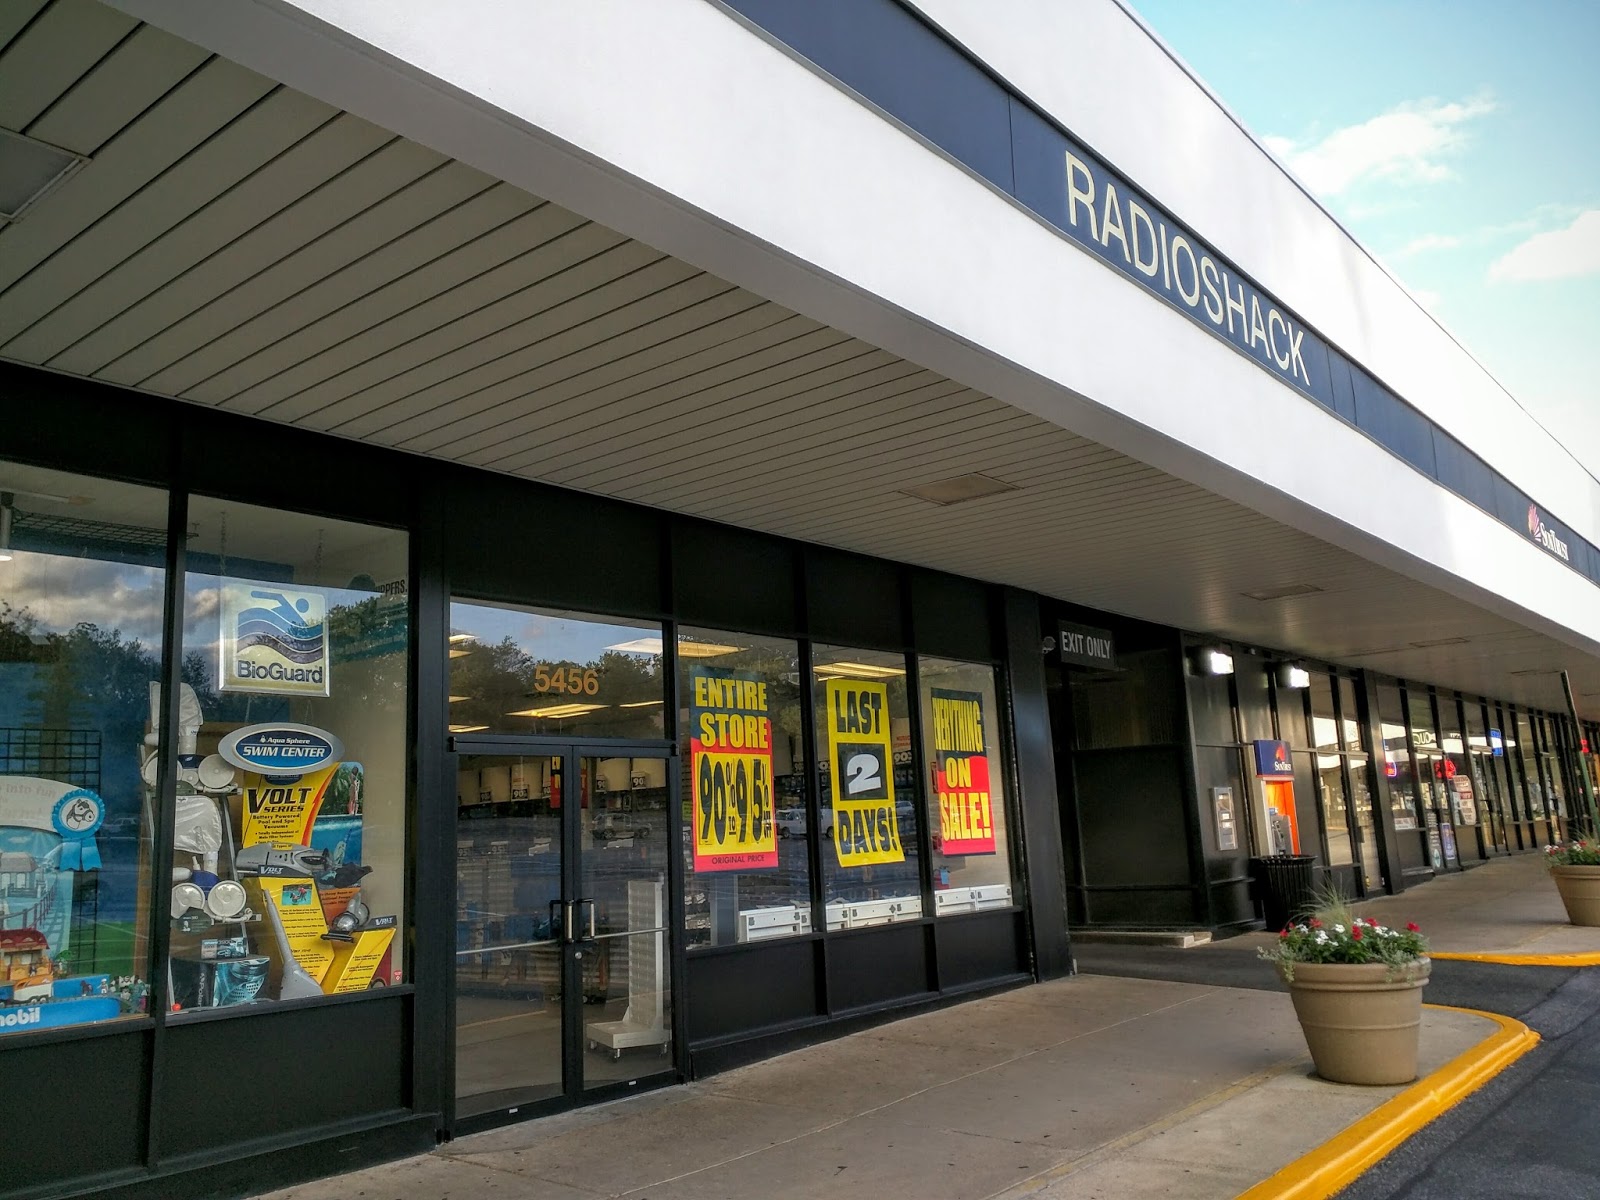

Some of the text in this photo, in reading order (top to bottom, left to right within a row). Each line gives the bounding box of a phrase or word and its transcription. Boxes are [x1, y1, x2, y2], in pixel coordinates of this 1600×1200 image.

[1065, 150, 1310, 386] RADIOSHACK
[1061, 631, 1111, 659] EXIT ONLY
[237, 660, 323, 684] BioGuard
[534, 666, 599, 695] 5456
[695, 676, 767, 711] ENTIRE
[835, 690, 881, 734] LAST
[932, 698, 983, 752] EVERYTHING
[700, 712, 769, 749] STORE
[243, 746, 325, 757] SWIM CENTER
[846, 753, 881, 794] 2
[946, 757, 971, 788] ON
[247, 788, 312, 814] VOLT
[264, 805, 304, 813] SERIES
[939, 792, 991, 840] SALE!
[837, 807, 897, 854] DAYS!
[711, 856, 745, 865] ORIGINAL
